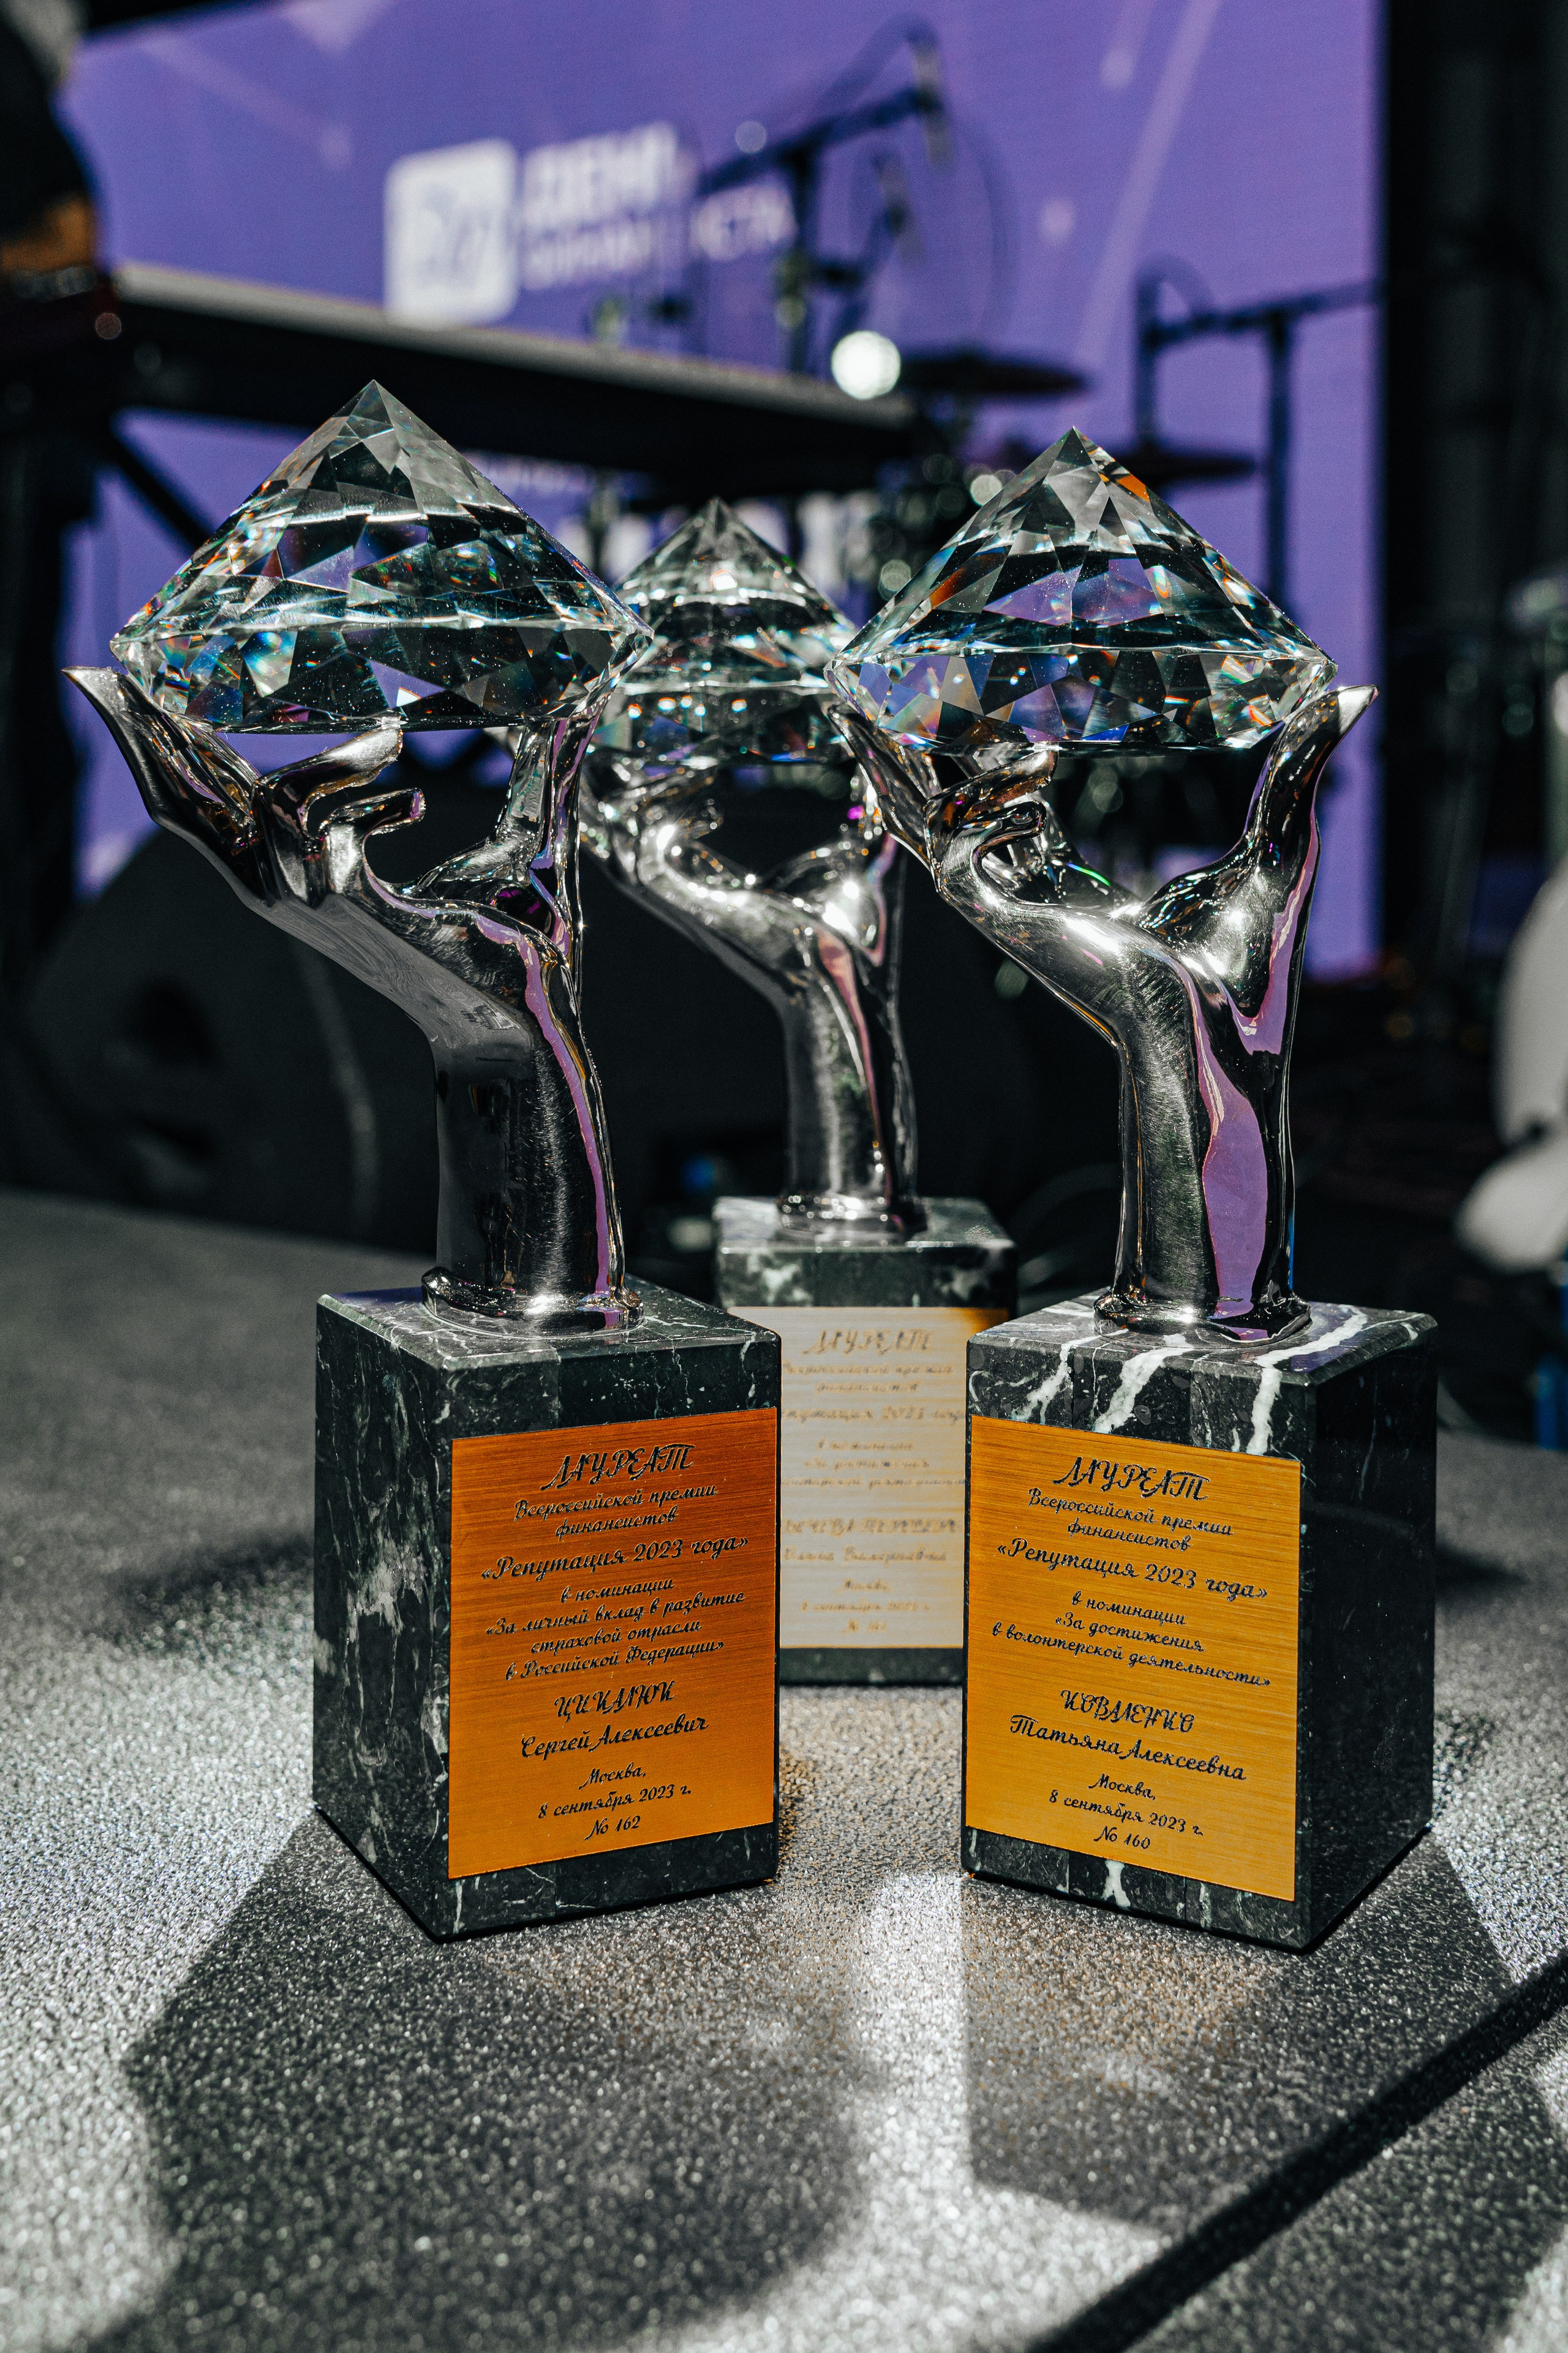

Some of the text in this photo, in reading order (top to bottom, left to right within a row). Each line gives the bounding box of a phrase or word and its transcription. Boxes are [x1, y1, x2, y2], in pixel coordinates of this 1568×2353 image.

[540, 1443, 695, 1491] ЛАУРЕАТ
[1052, 1456, 1210, 1501] ЛАУРЕАТ
[514, 1483, 718, 1522] Всероссийской премии
[555, 1505, 680, 1540] финансистов
[1028, 1487, 1234, 1536] Всероссийской премии
[1066, 1517, 1192, 1552] финансистов
[481, 1535, 750, 1582] «Репутация 2023 года»
[997, 1537, 1268, 1602] «Репутация 2023 года»
[561, 1577, 675, 1603] в номинации
[1071, 1591, 1187, 1626] в номинации
[485, 1590, 746, 1636] «За личный вклад в развитие
[1055, 1612, 1207, 1653] «За достижения
[530, 1618, 703, 1655] страховой отрасли
[992, 1622, 1272, 1686] в волонтерской деятельности»
[505, 1639, 725, 1681] в Российской Федерации»
[554, 1680, 676, 1723] ЦИКАЛЮК
[1060, 1690, 1196, 1734] КОВАЛЕНКО
[520, 1713, 710, 1761] Сергей Алексеевич
[1009, 1715, 1247, 1781] Татьяна Алексеевна
[579, 1762, 647, 1789] Москва,
[1088, 1773, 1157, 1801] Москва,
[538, 1784, 692, 1819] 8 сентября 2023 г.
[1049, 1789, 1204, 1837] 8 сентября 2023 г.
[614, 1815, 641, 1832] 162
[1123, 1833, 1151, 1849] 160
